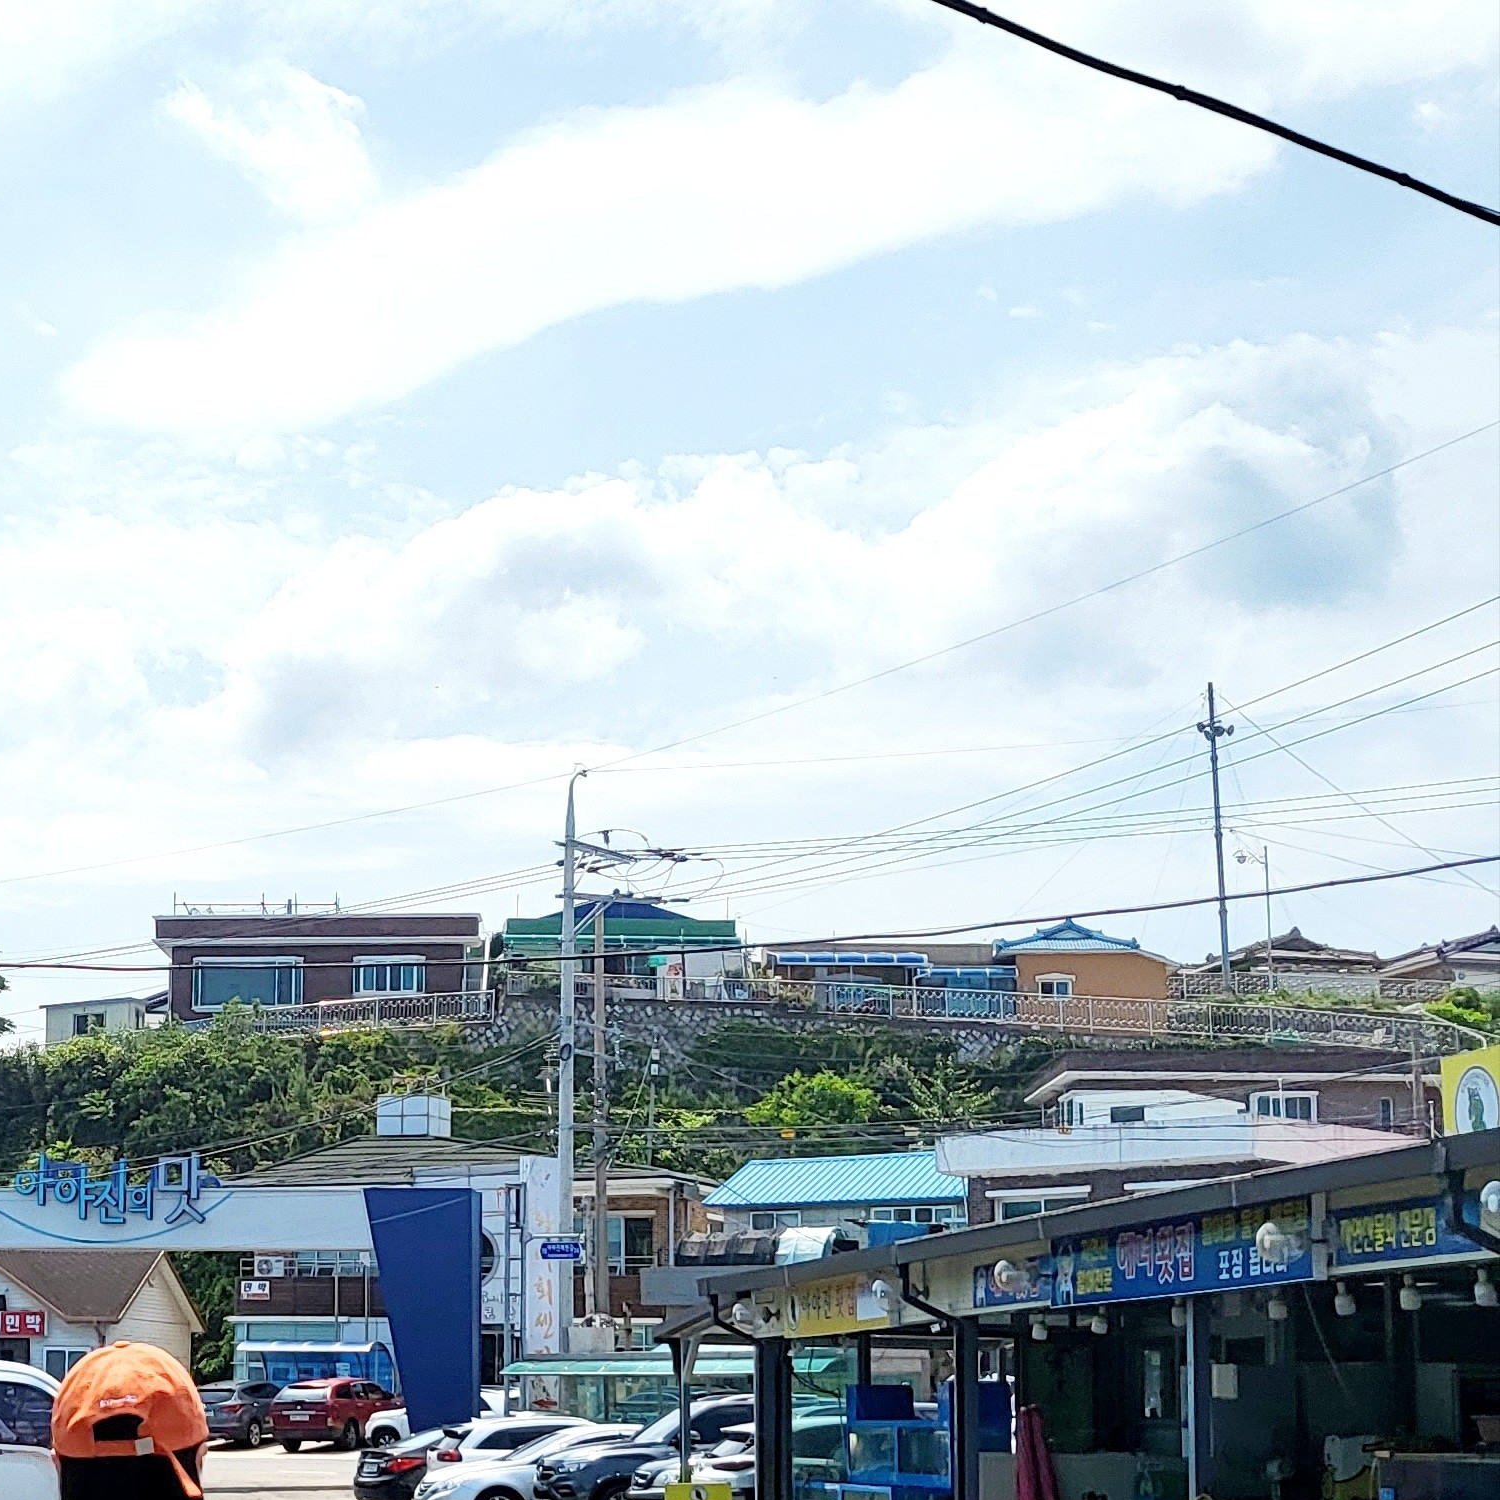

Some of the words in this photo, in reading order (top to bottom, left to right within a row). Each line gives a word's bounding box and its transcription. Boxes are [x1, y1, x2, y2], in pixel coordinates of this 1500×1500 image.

[15, 1153, 153, 1224] 아야진의
[158, 1152, 204, 1223] 맛
[1218, 1248, 1243, 1280] 포장
[5, 1314, 42, 1334] 민박
